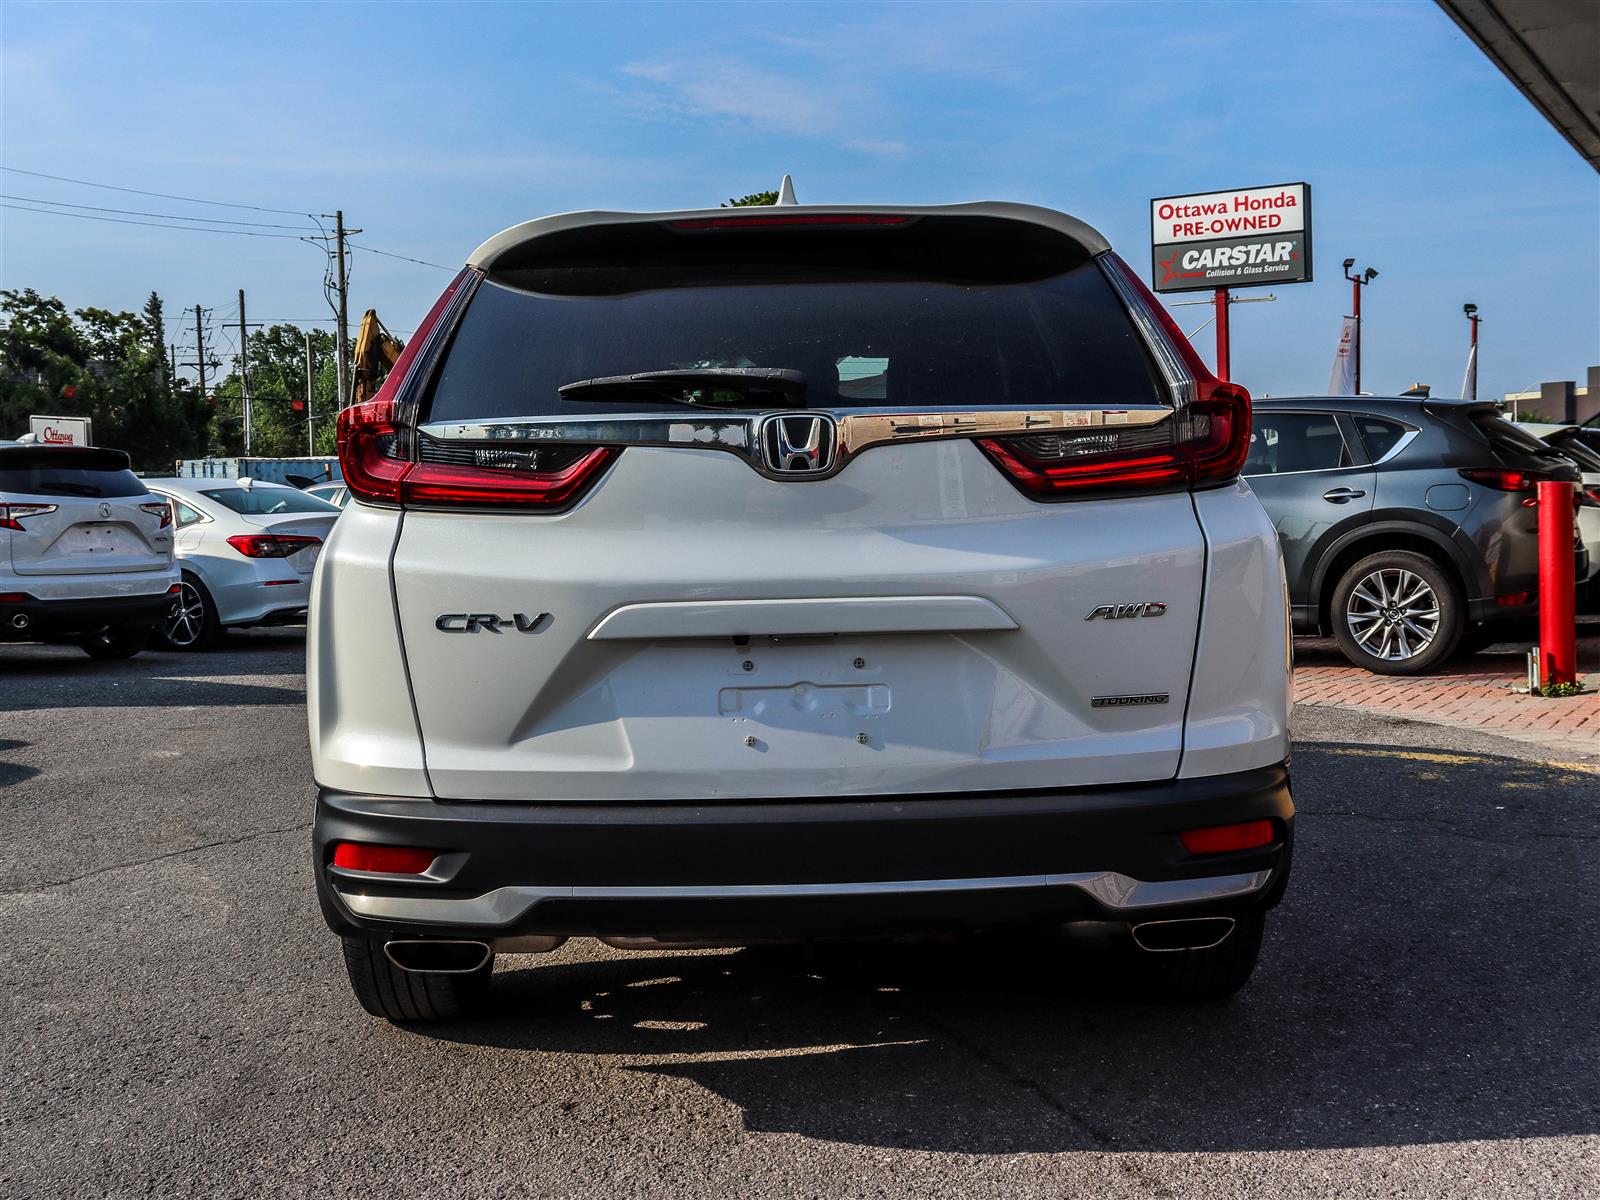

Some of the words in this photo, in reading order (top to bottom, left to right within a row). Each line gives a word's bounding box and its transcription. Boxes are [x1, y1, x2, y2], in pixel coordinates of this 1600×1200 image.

[1158, 202, 1228, 221] Ottawa
[1234, 191, 1297, 213] Honda
[1172, 214, 1282, 238] PRE-OWNED
[1182, 241, 1293, 270] CARSTAR
[1206, 269, 1235, 278] Collision
[1236, 267, 1242, 275] &
[1243, 266, 1263, 275] Glass
[1263, 264, 1290, 273] Service
[44, 426, 73, 441] Ottawa
[1084, 602, 1168, 621] AWD
[435, 612, 556, 635] CR-V
[1098, 694, 1165, 706] TOURING
